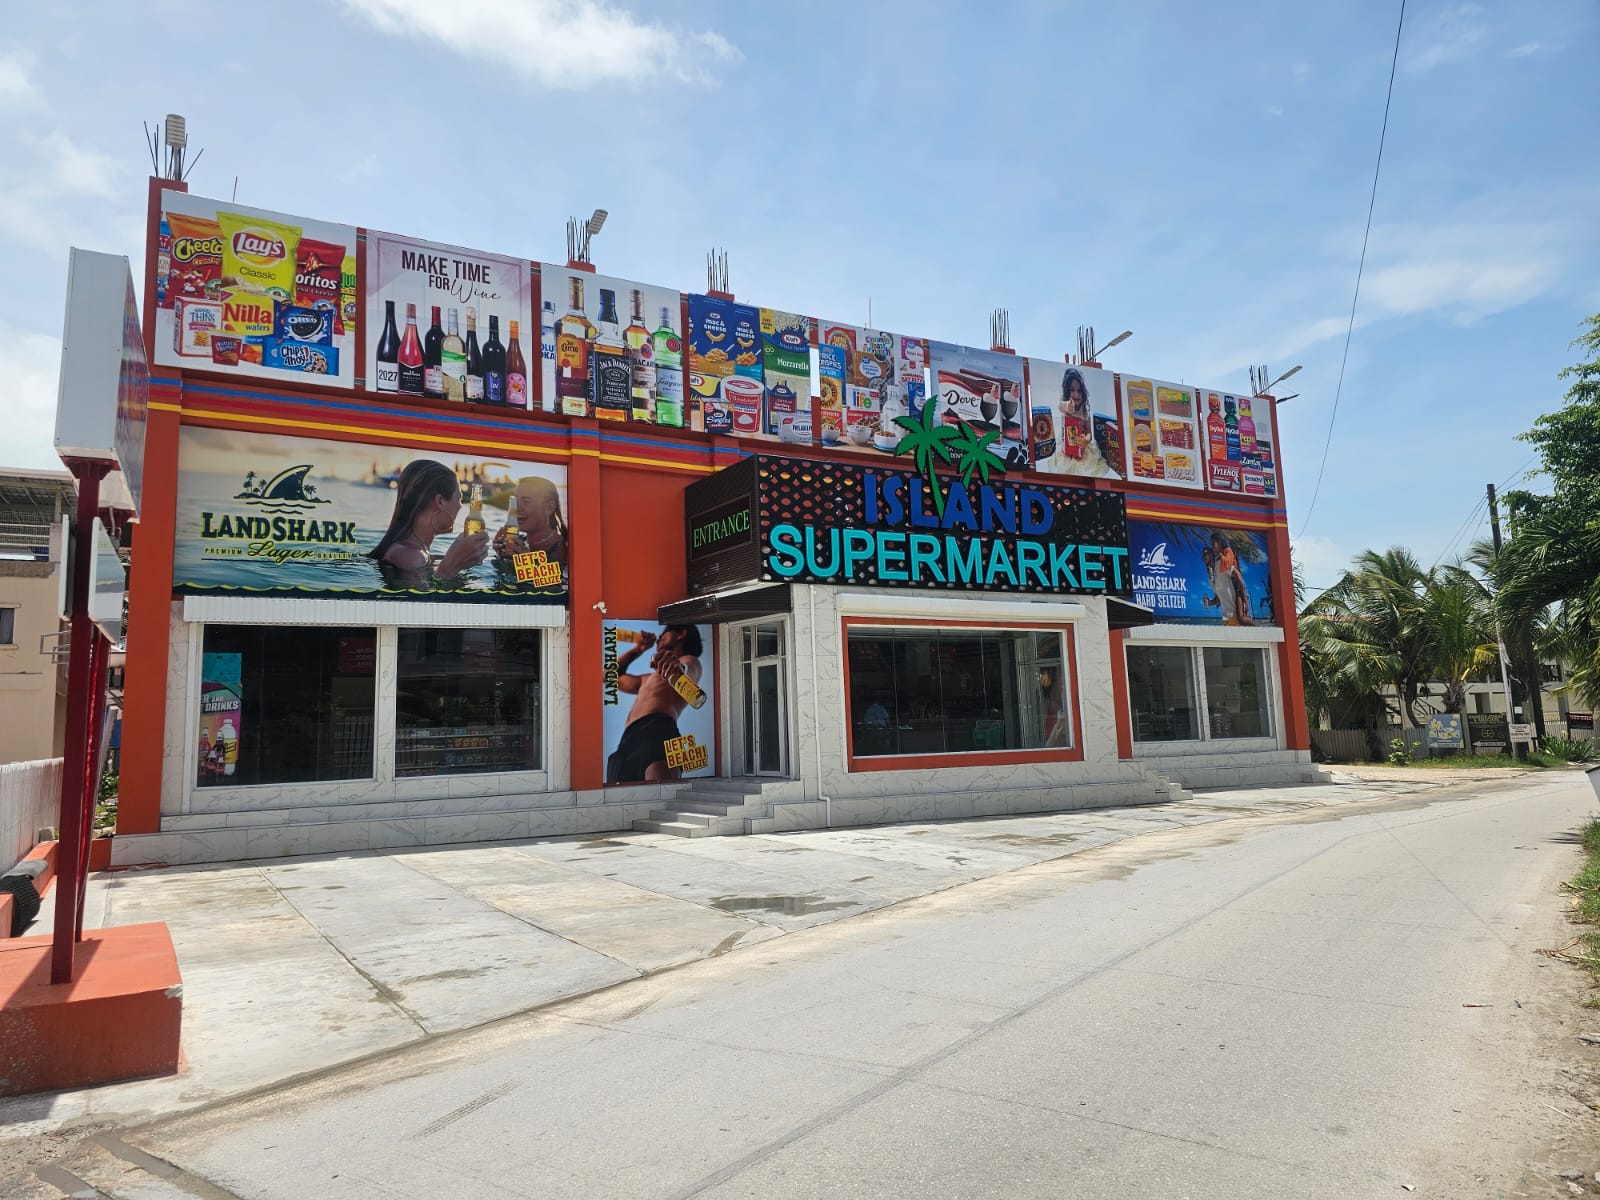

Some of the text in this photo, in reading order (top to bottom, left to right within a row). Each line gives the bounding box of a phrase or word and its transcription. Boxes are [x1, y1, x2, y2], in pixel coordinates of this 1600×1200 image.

[239, 266, 276, 281] Classic
[402, 250, 491, 284] MAKE TIME
[429, 274, 502, 304] FOR Wine
[223, 302, 272, 324] Nilla
[288, 316, 317, 324] OREO
[246, 323, 270, 331] wafers
[777, 358, 809, 370] Mozzarella
[821, 353, 836, 361] RICE
[1213, 464, 1240, 477] TYLENOL
[864, 473, 1055, 537] ISLAND
[692, 507, 751, 549] ENTRANCE
[205, 547, 243, 555] PREMIUM
[247, 541, 315, 566] Lager
[317, 552, 352, 560] QUALITY
[513, 551, 546, 567] LET'S
[768, 522, 1129, 590] SUPERMARKET
[517, 563, 560, 581] BEACH!
[534, 575, 561, 587] BELIZE
[1135, 593, 1187, 609] HARD SELTZER
[205, 700, 239, 712] DRINKS
[664, 734, 695, 753] LET'S
[667, 745, 708, 768] BEACH!
[683, 758, 708, 772] BELIZE
